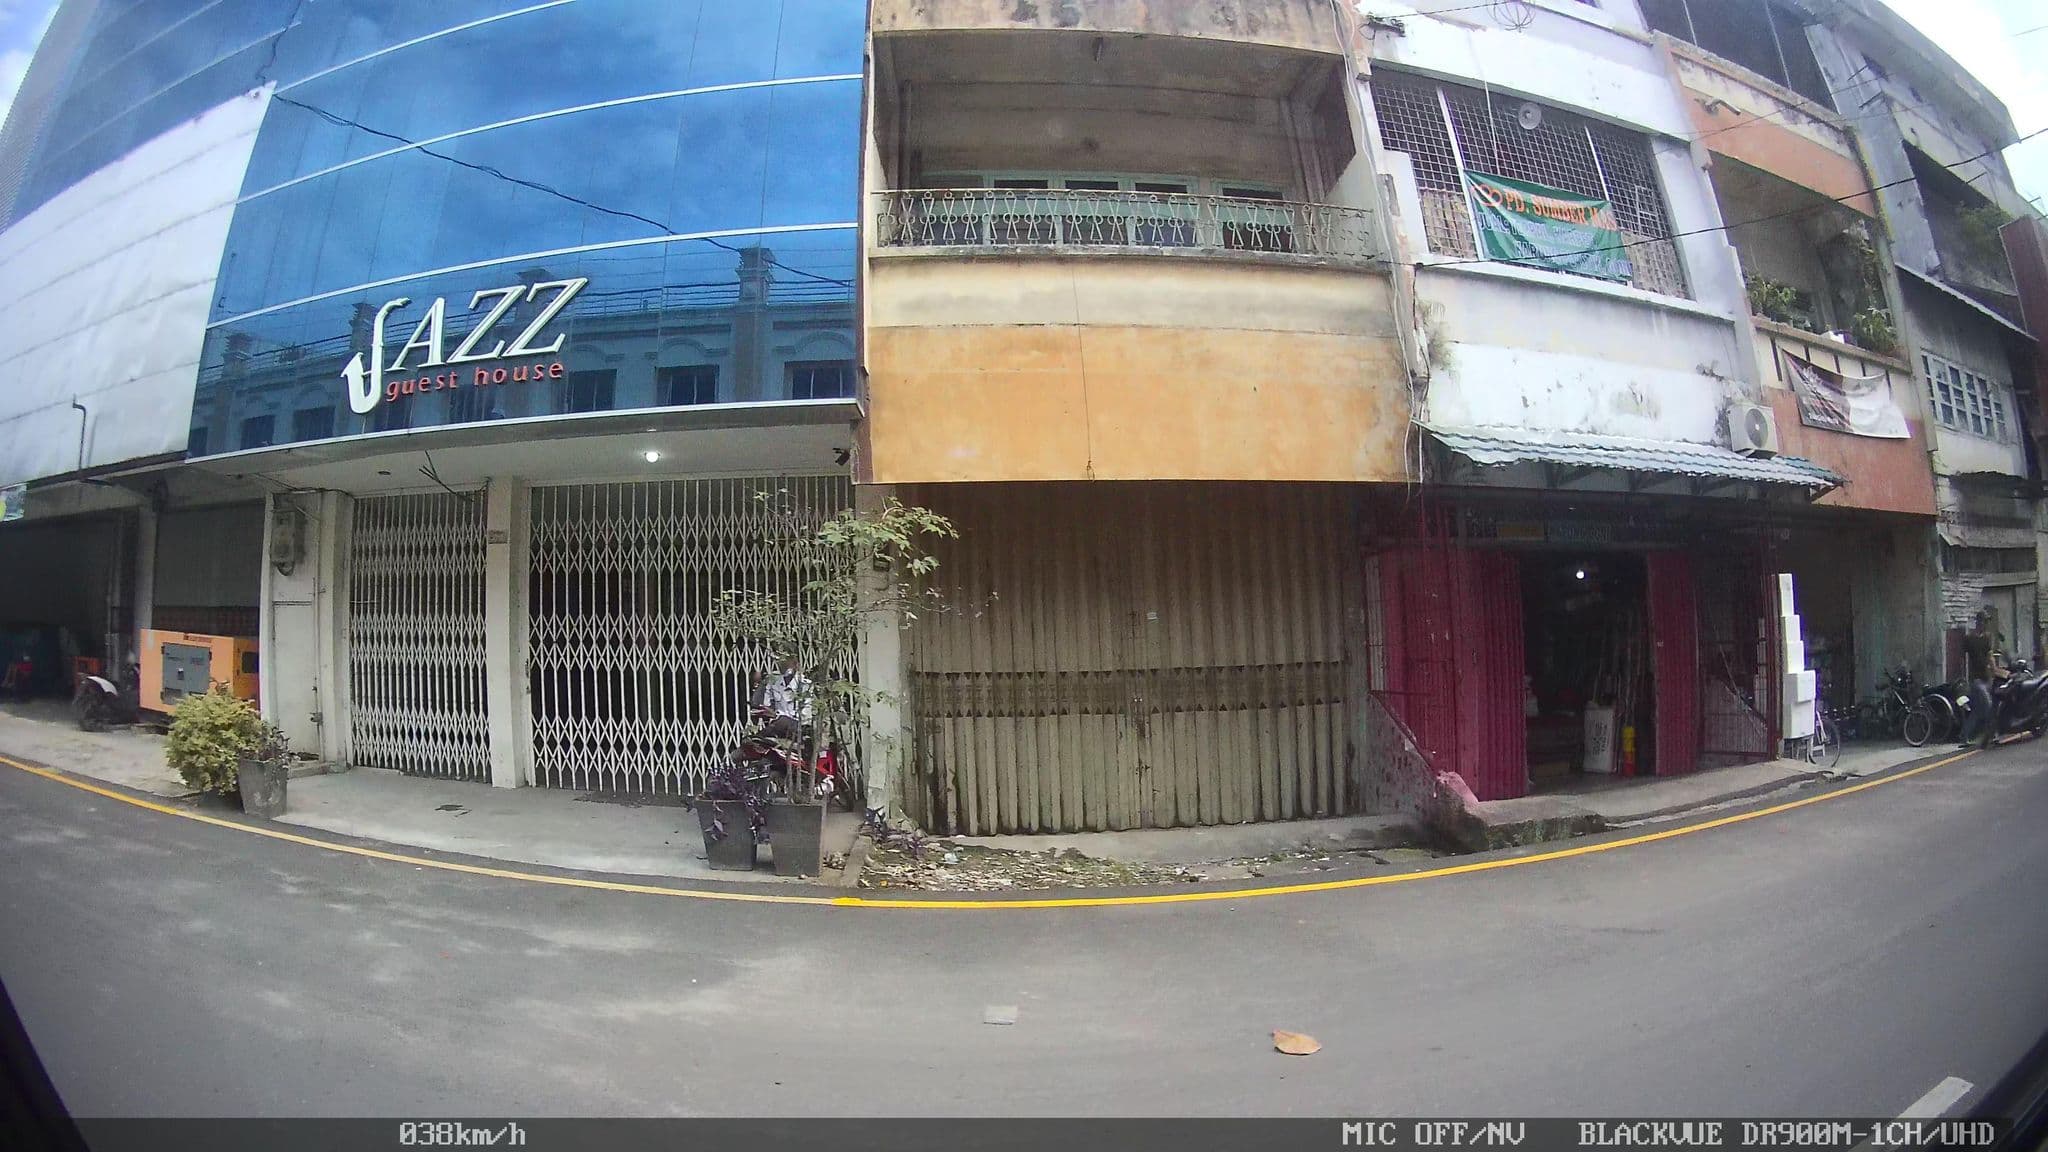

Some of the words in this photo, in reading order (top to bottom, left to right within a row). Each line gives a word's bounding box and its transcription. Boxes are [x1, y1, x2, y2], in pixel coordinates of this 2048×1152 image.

[1533, 195, 1589, 225] SUMBER
[340, 277, 588, 414] JAZZ
[386, 370, 460, 402] guest
[474, 361, 565, 387] house
